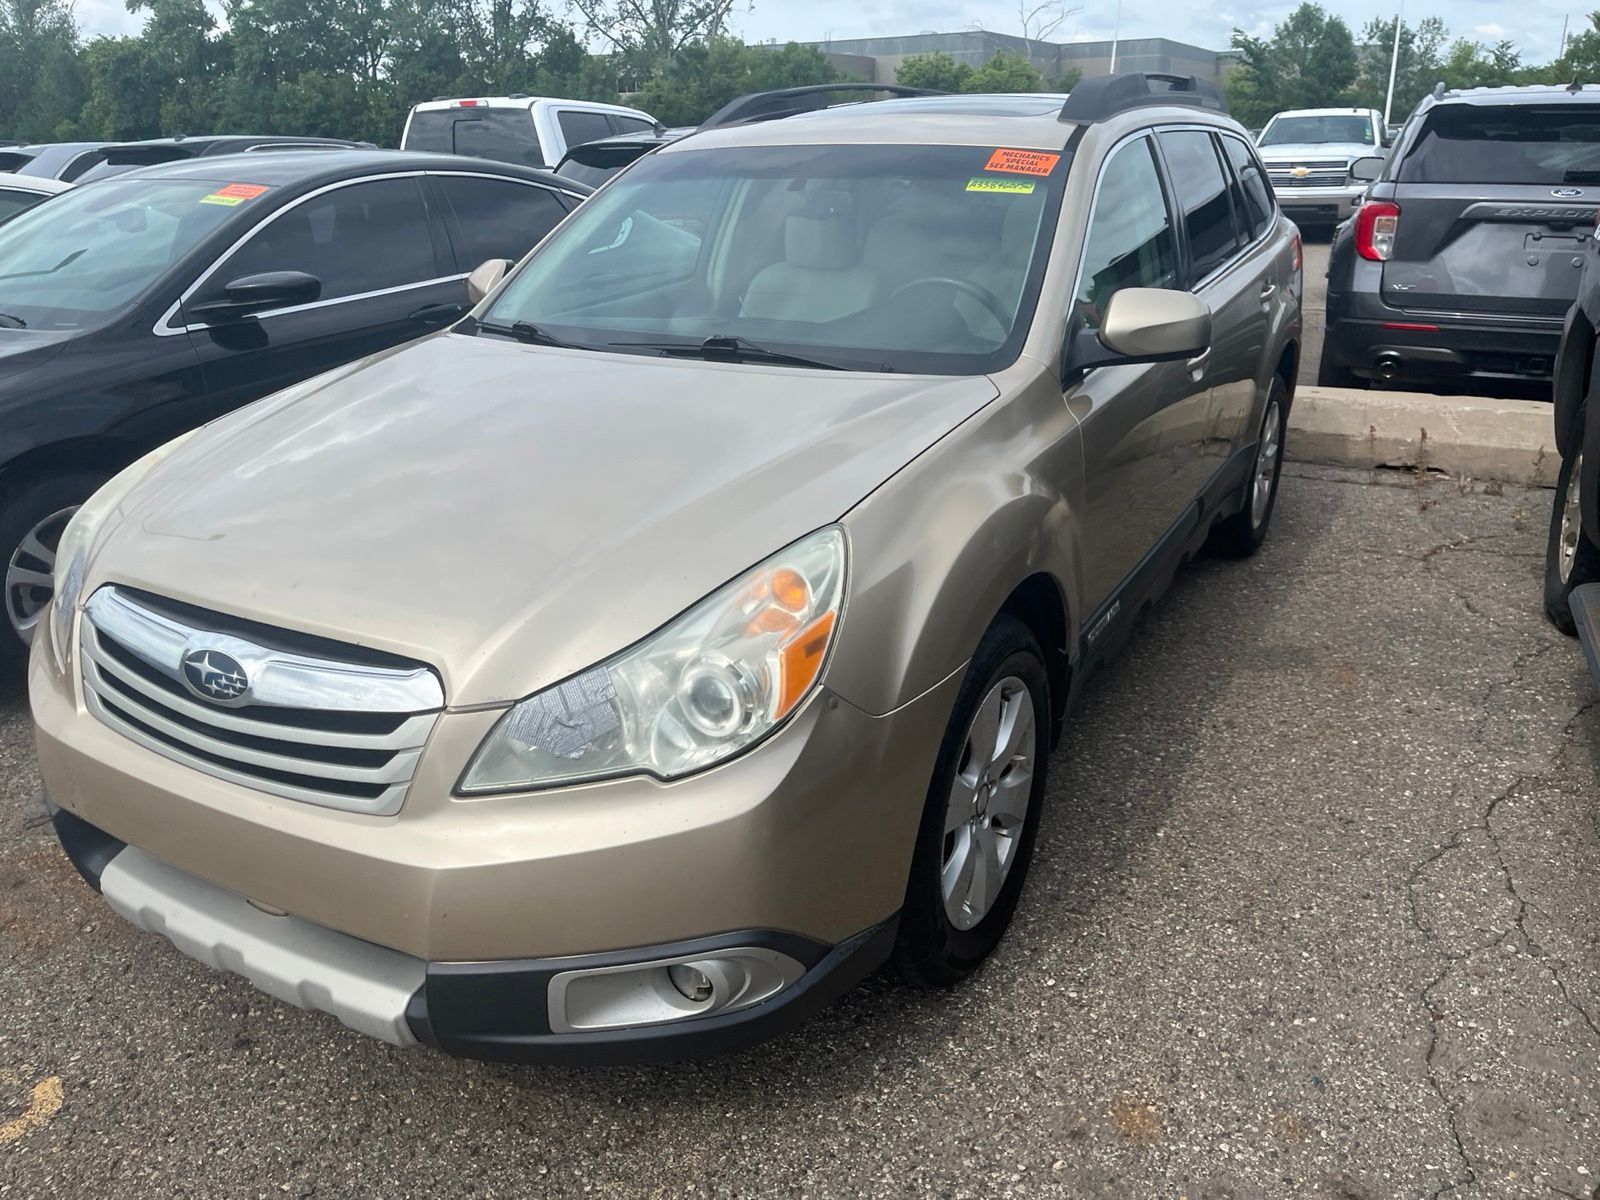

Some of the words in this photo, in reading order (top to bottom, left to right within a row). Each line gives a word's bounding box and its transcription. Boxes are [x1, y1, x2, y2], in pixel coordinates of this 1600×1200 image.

[1002, 151, 1051, 161] MECHANICS
[1005, 157, 1039, 166] SPECIAL
[1006, 163, 1049, 174] MANAGER
